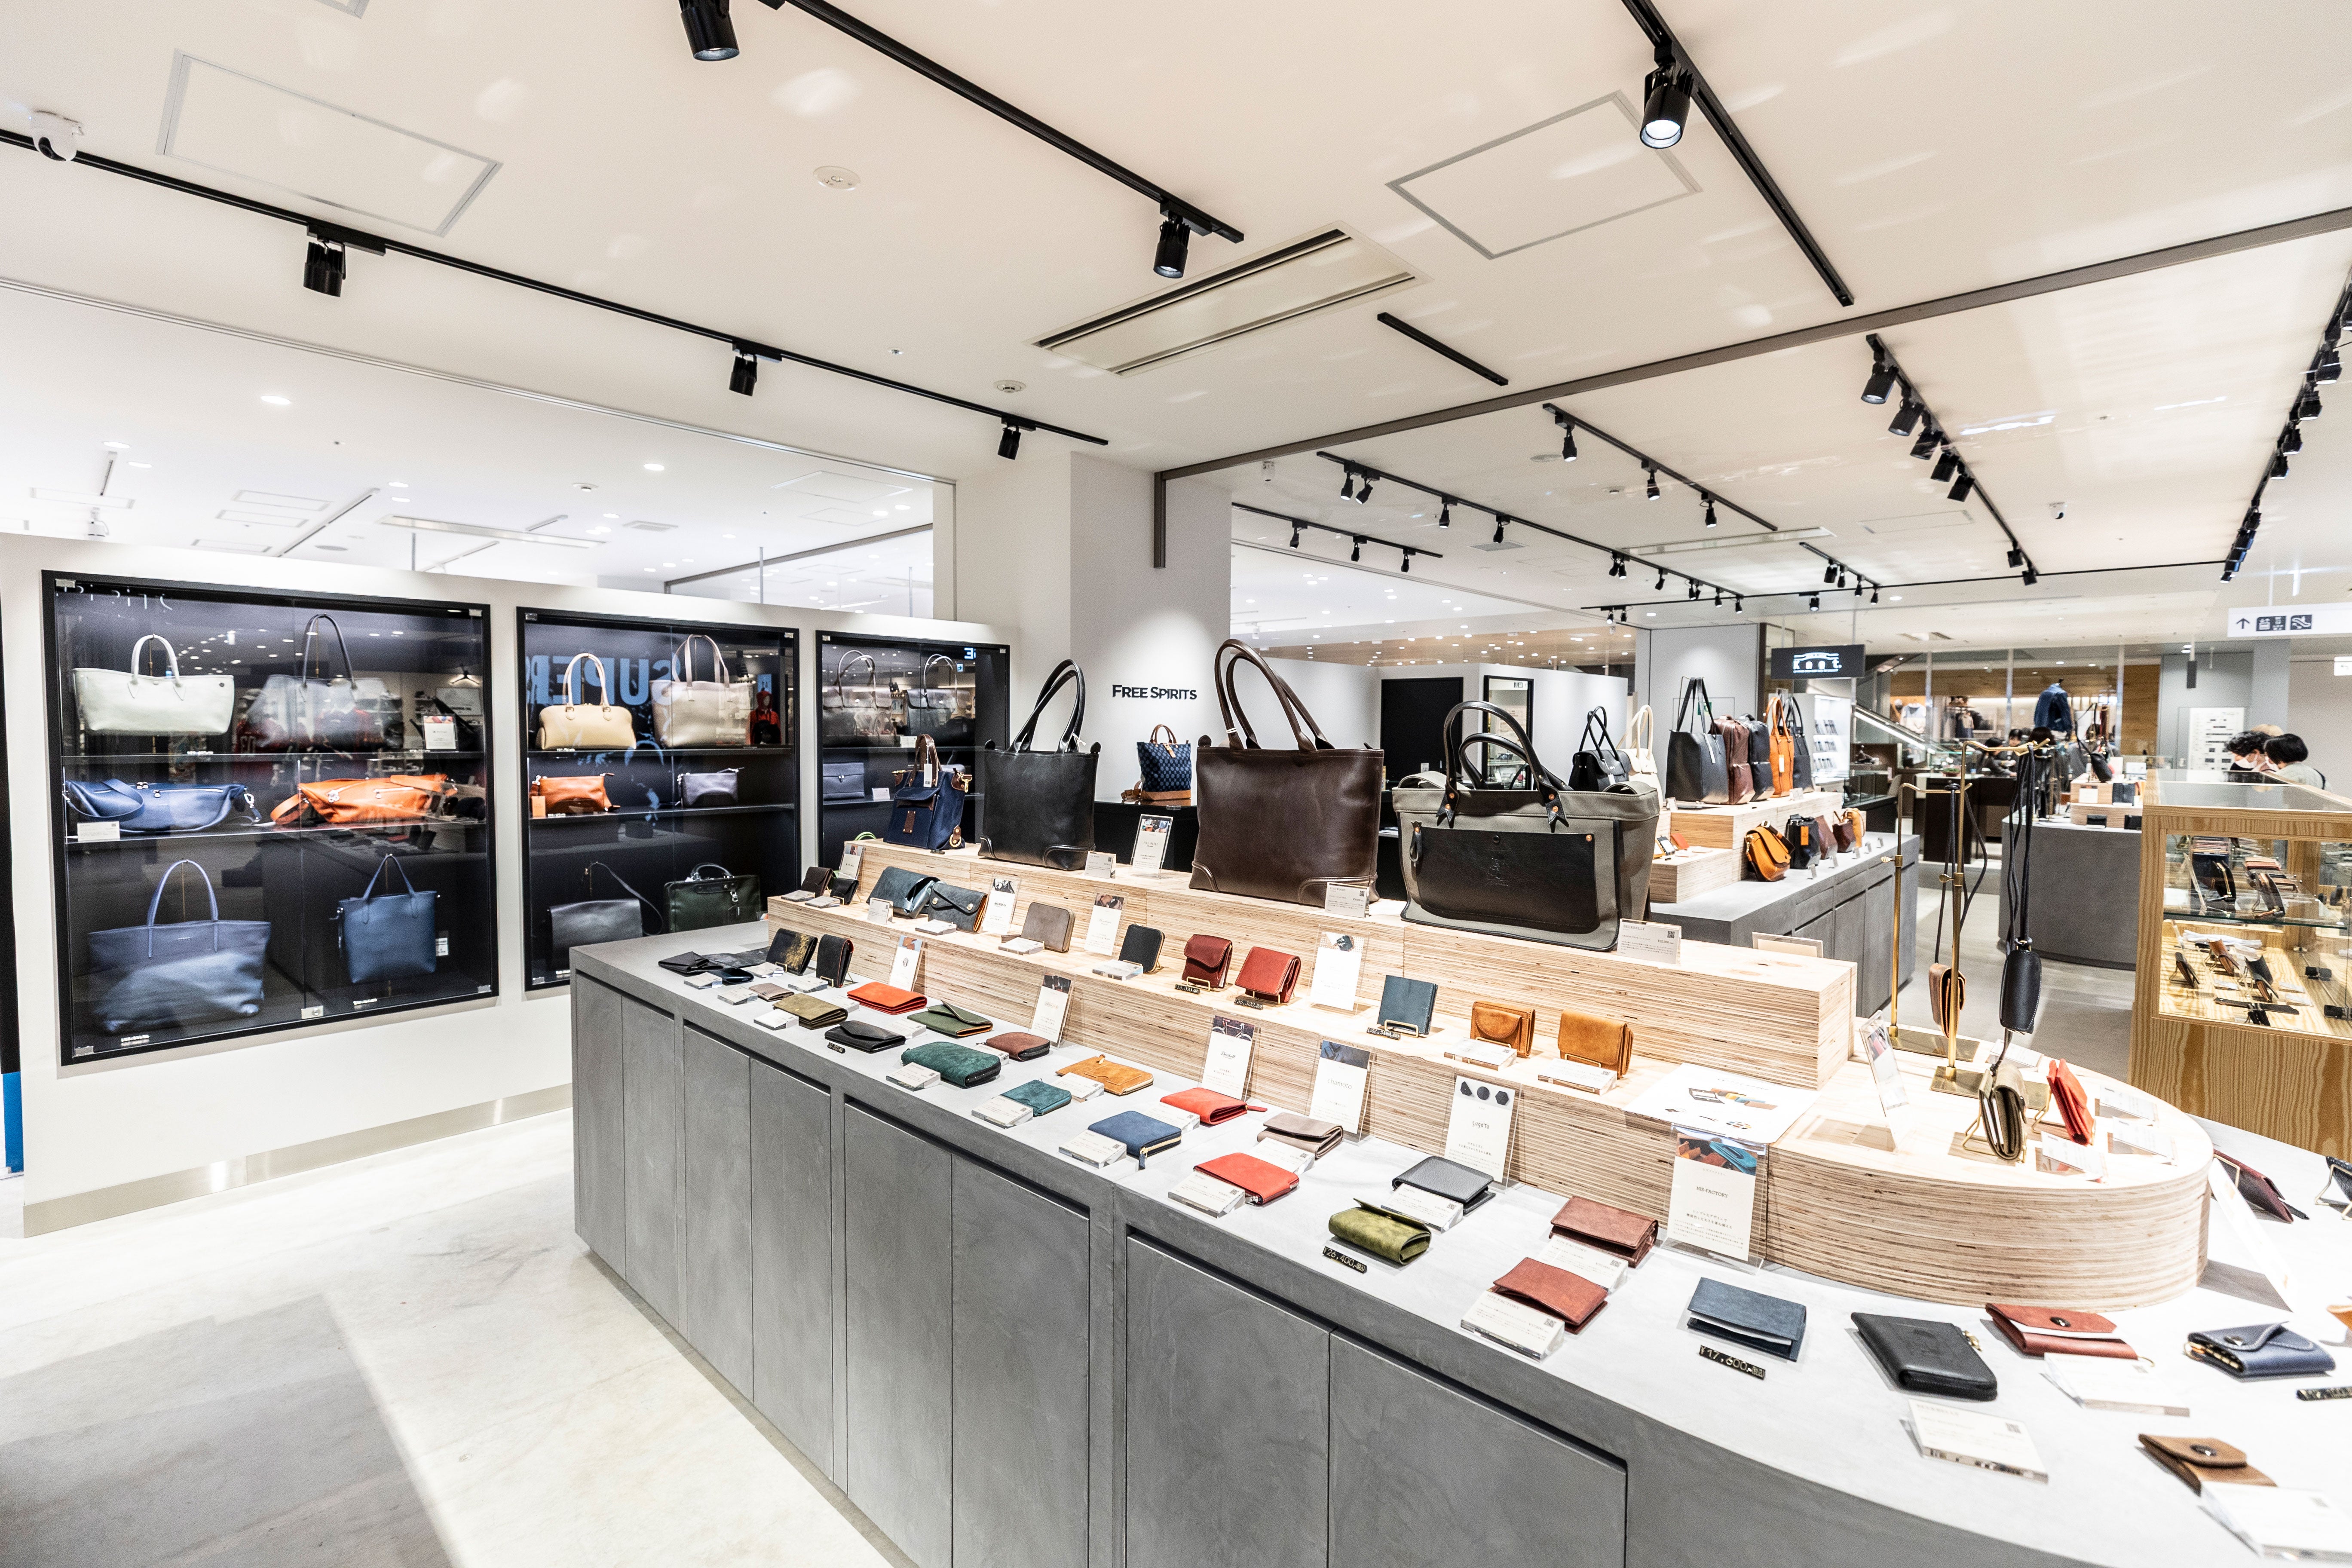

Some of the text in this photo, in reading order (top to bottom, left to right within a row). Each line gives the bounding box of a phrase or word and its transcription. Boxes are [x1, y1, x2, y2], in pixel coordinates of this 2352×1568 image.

[1112, 685, 1197, 700] FREE SPIRITS
[1327, 1078, 1352, 1089] chamoto
[1472, 1121, 1489, 1129] sugata
[1696, 1186, 1728, 1198] HIS-FACTORY
